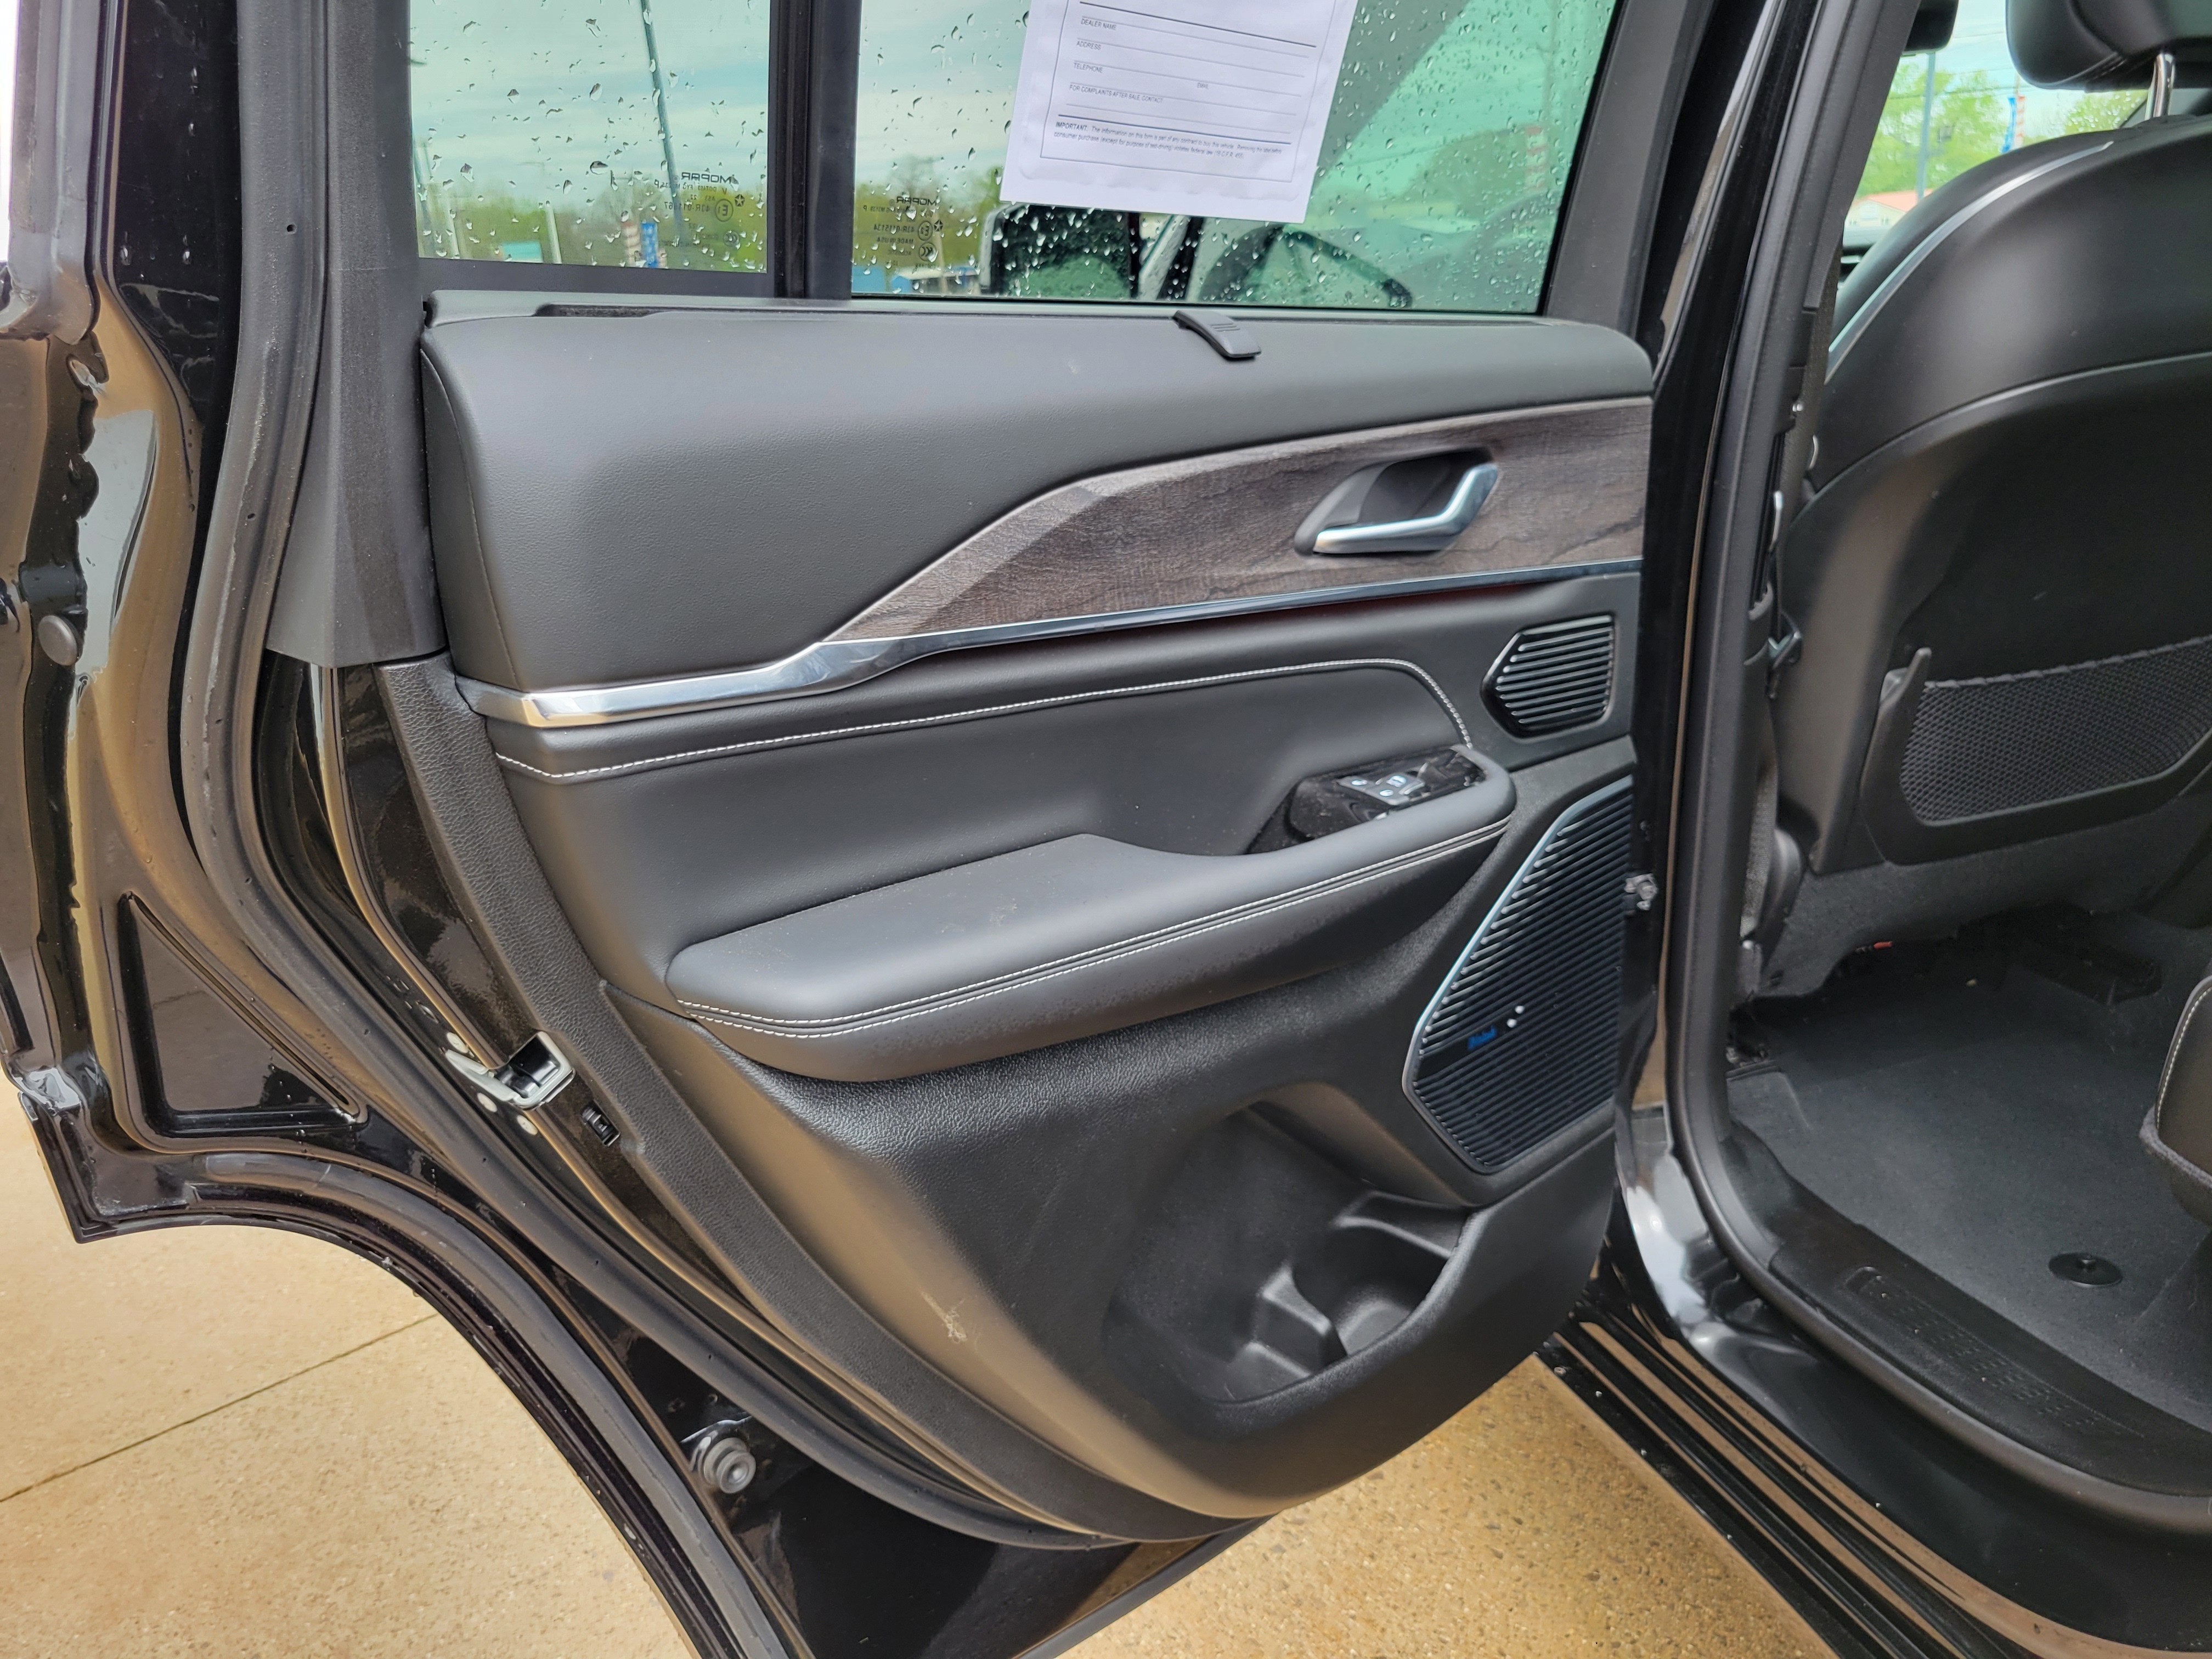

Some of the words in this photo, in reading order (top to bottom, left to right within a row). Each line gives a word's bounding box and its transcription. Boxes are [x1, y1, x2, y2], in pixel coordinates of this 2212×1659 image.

[1081, 18, 1102, 28] DEALER
[1076, 41, 1101, 50] ADDRESS
[1073, 62, 1103, 73] TELEPHONE
[1081, 86, 1112, 96] COMPLAINTS
[1101, 128, 1128, 136] information
